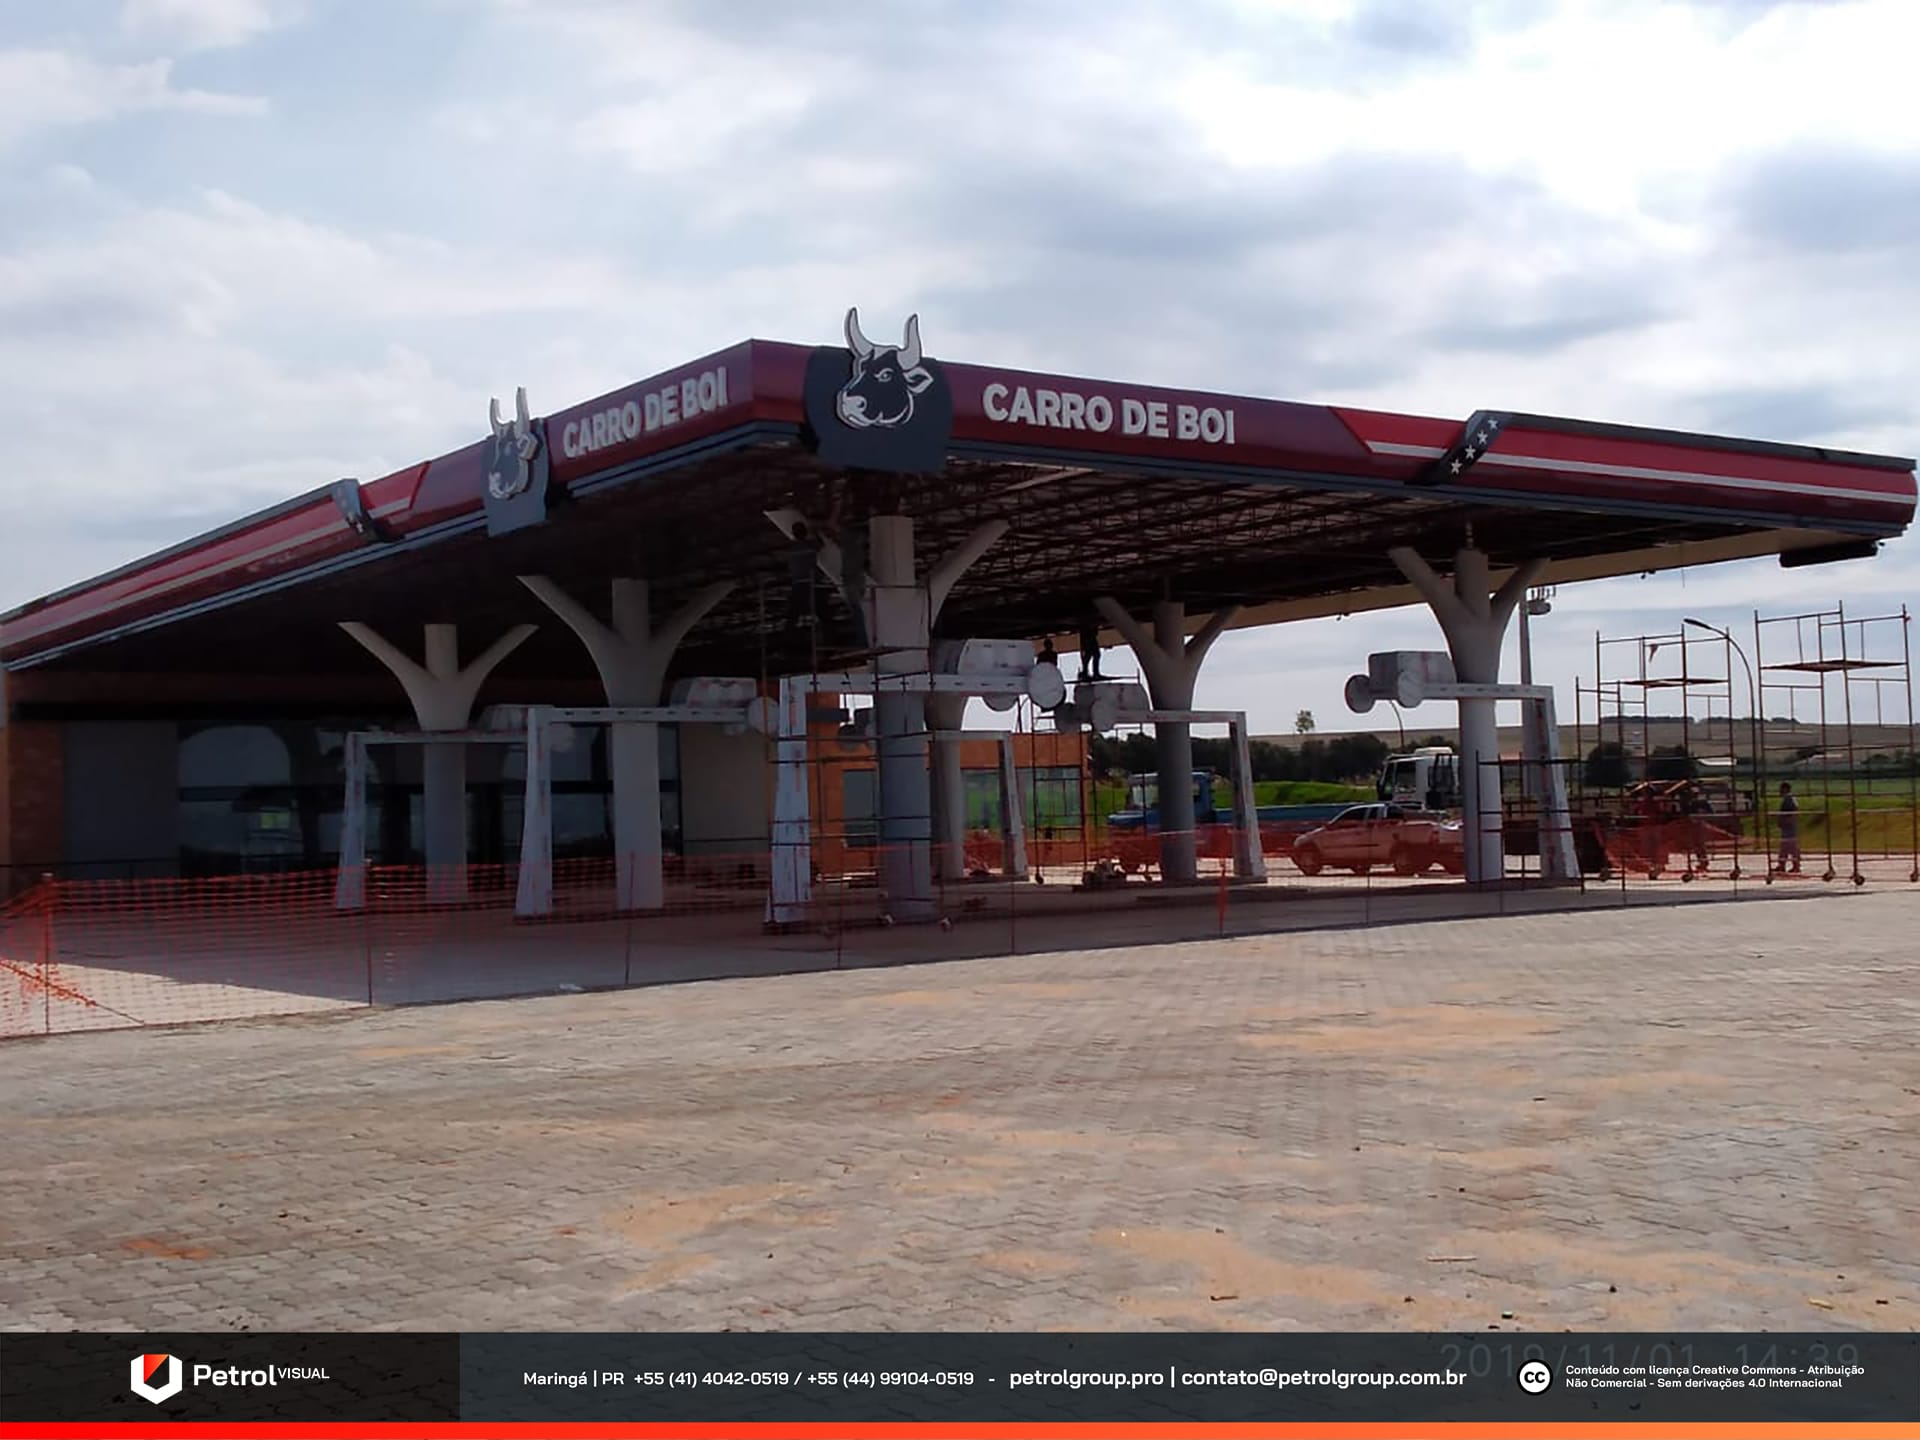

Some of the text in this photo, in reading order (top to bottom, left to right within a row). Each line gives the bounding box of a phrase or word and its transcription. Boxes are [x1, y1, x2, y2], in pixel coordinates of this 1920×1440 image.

[562, 366, 729, 459] CARRO DE BOI
[982, 383, 1236, 445] CARRO DE BOI
